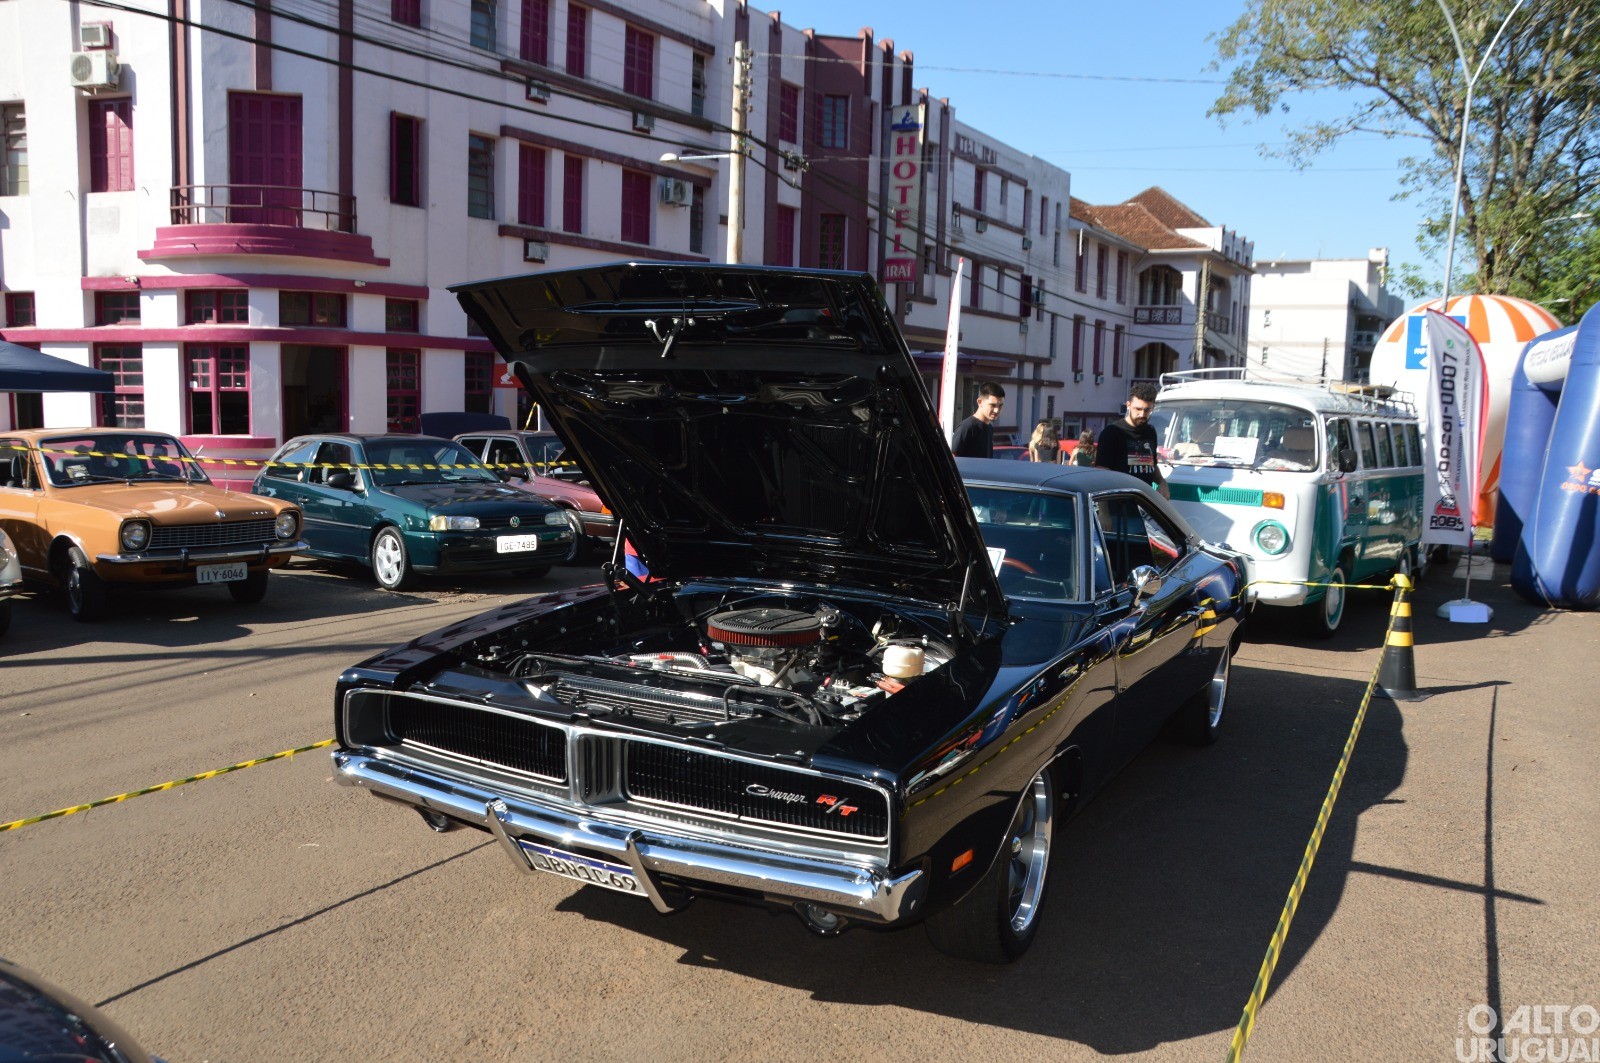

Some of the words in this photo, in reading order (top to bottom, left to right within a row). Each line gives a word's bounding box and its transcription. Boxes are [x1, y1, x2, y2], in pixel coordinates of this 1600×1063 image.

[893, 135, 917, 253] HOTEL
[746, 784, 808, 804] Charger
[816, 794, 858, 816] R/T
